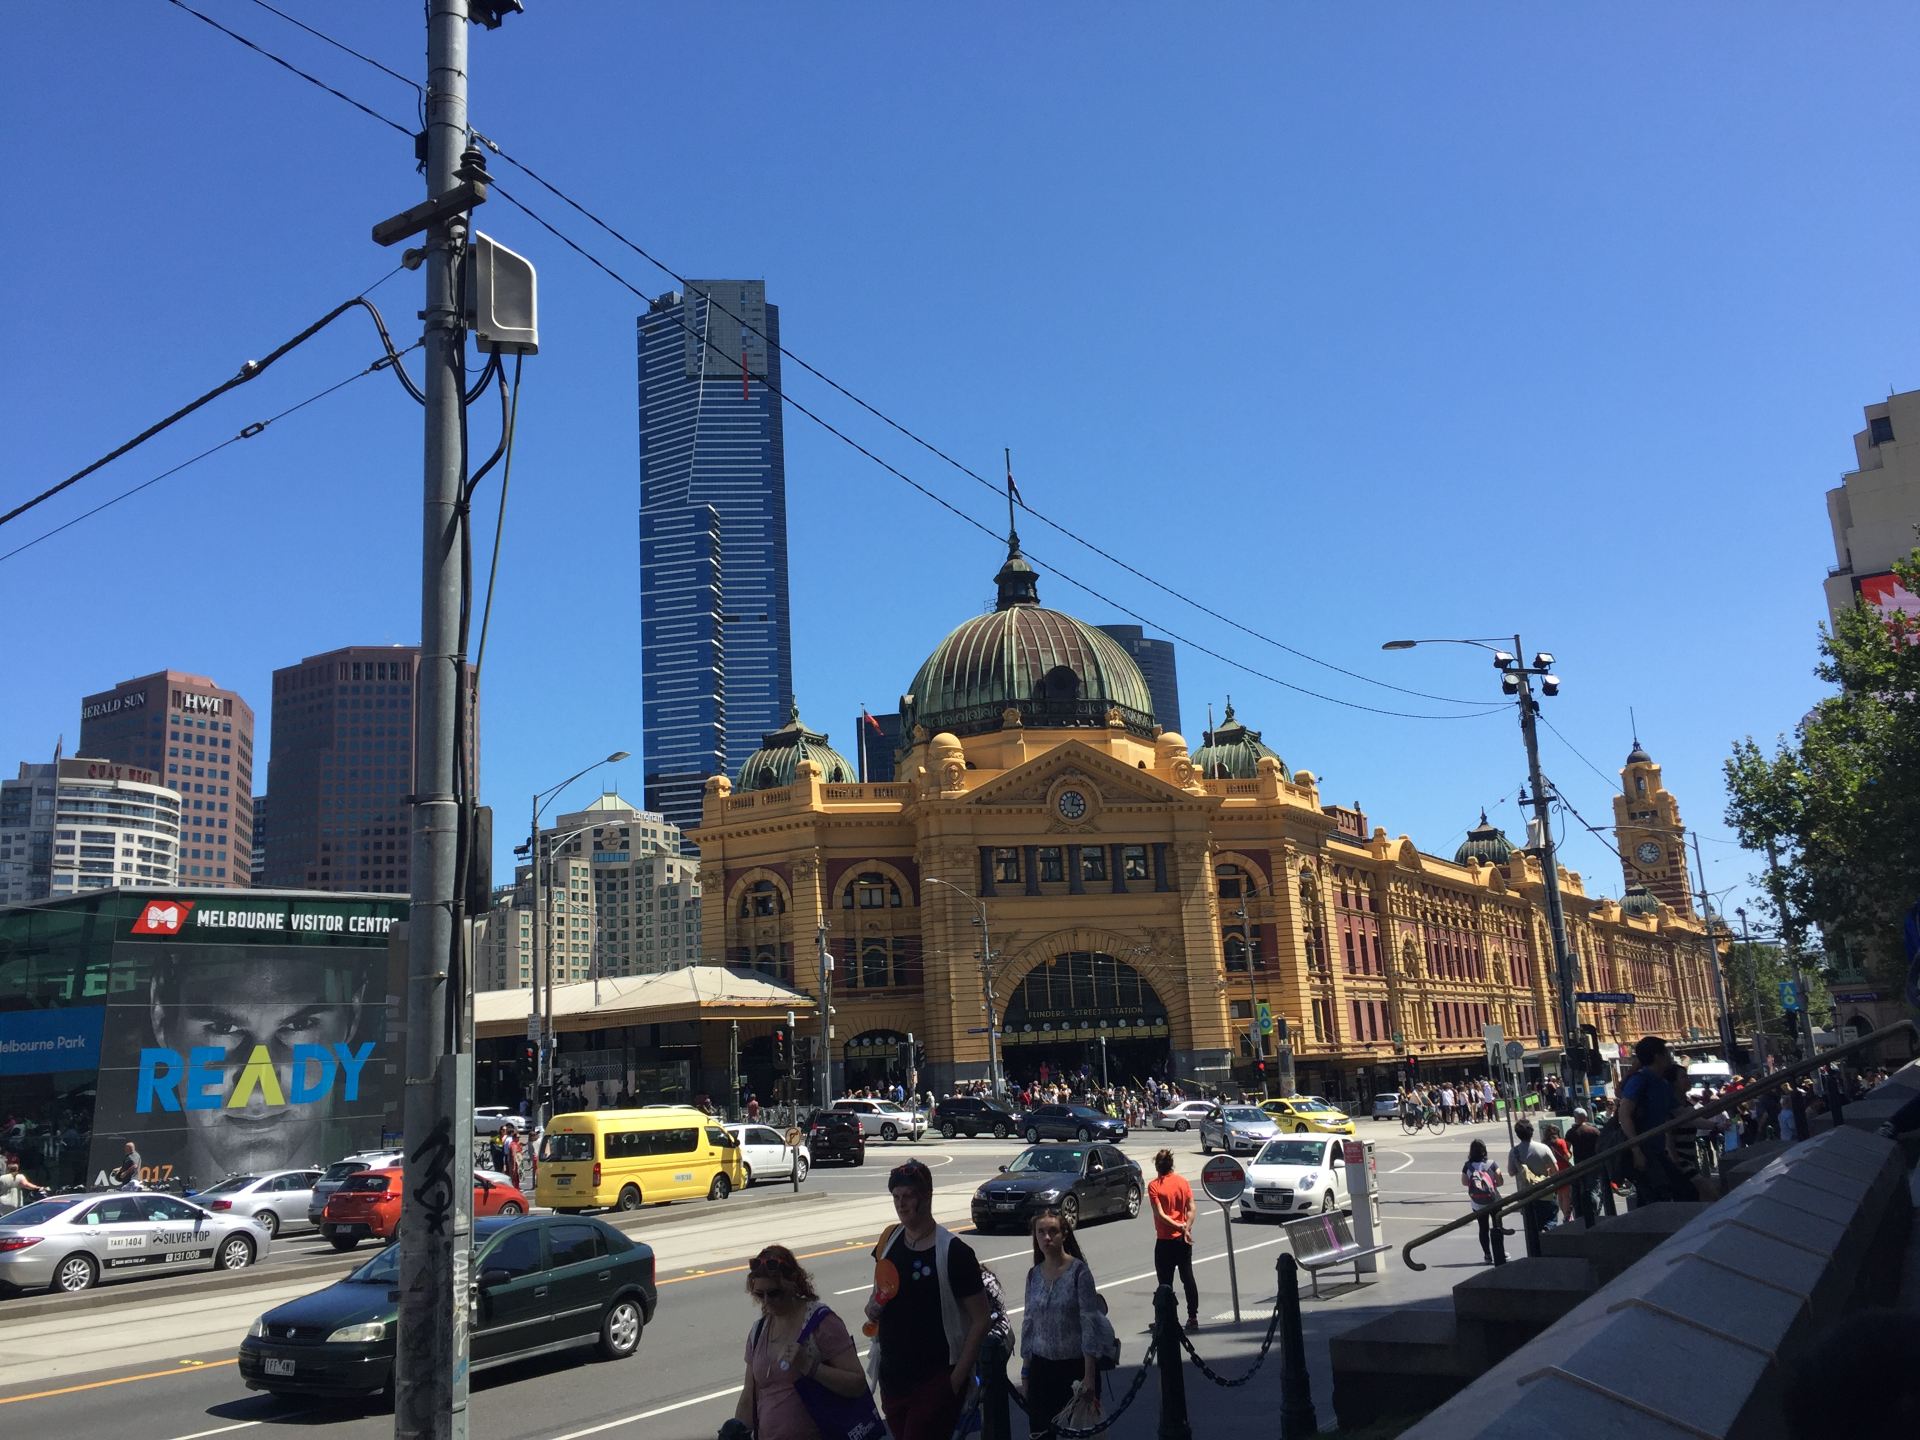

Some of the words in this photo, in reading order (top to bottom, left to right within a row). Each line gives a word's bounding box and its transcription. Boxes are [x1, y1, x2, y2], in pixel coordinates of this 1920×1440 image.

[82, 701, 121, 719] HERALD
[124, 692, 145, 708] SUN
[185, 693, 222, 712] HWT
[88, 764, 122, 780] QUAY
[633, 811, 664, 824] Langham
[197, 910, 284, 930] MELBOURNE
[291, 913, 343, 931] VISITOR
[1028, 1010, 1065, 1019] FLINDERS
[1074, 1008, 1102, 1017] STREET
[1110, 1007, 1143, 1015] STATION
[57, 1035, 86, 1049] Park
[136, 1042, 376, 1113] READY
[140, 1164, 173, 1183] 017
[125, 1237, 142, 1247] 1404
[164, 1232, 192, 1245] SILVER
[194, 1230, 210, 1242] TOP
[174, 1251, 184, 1261] 131
[185, 1250, 200, 1260] 008
